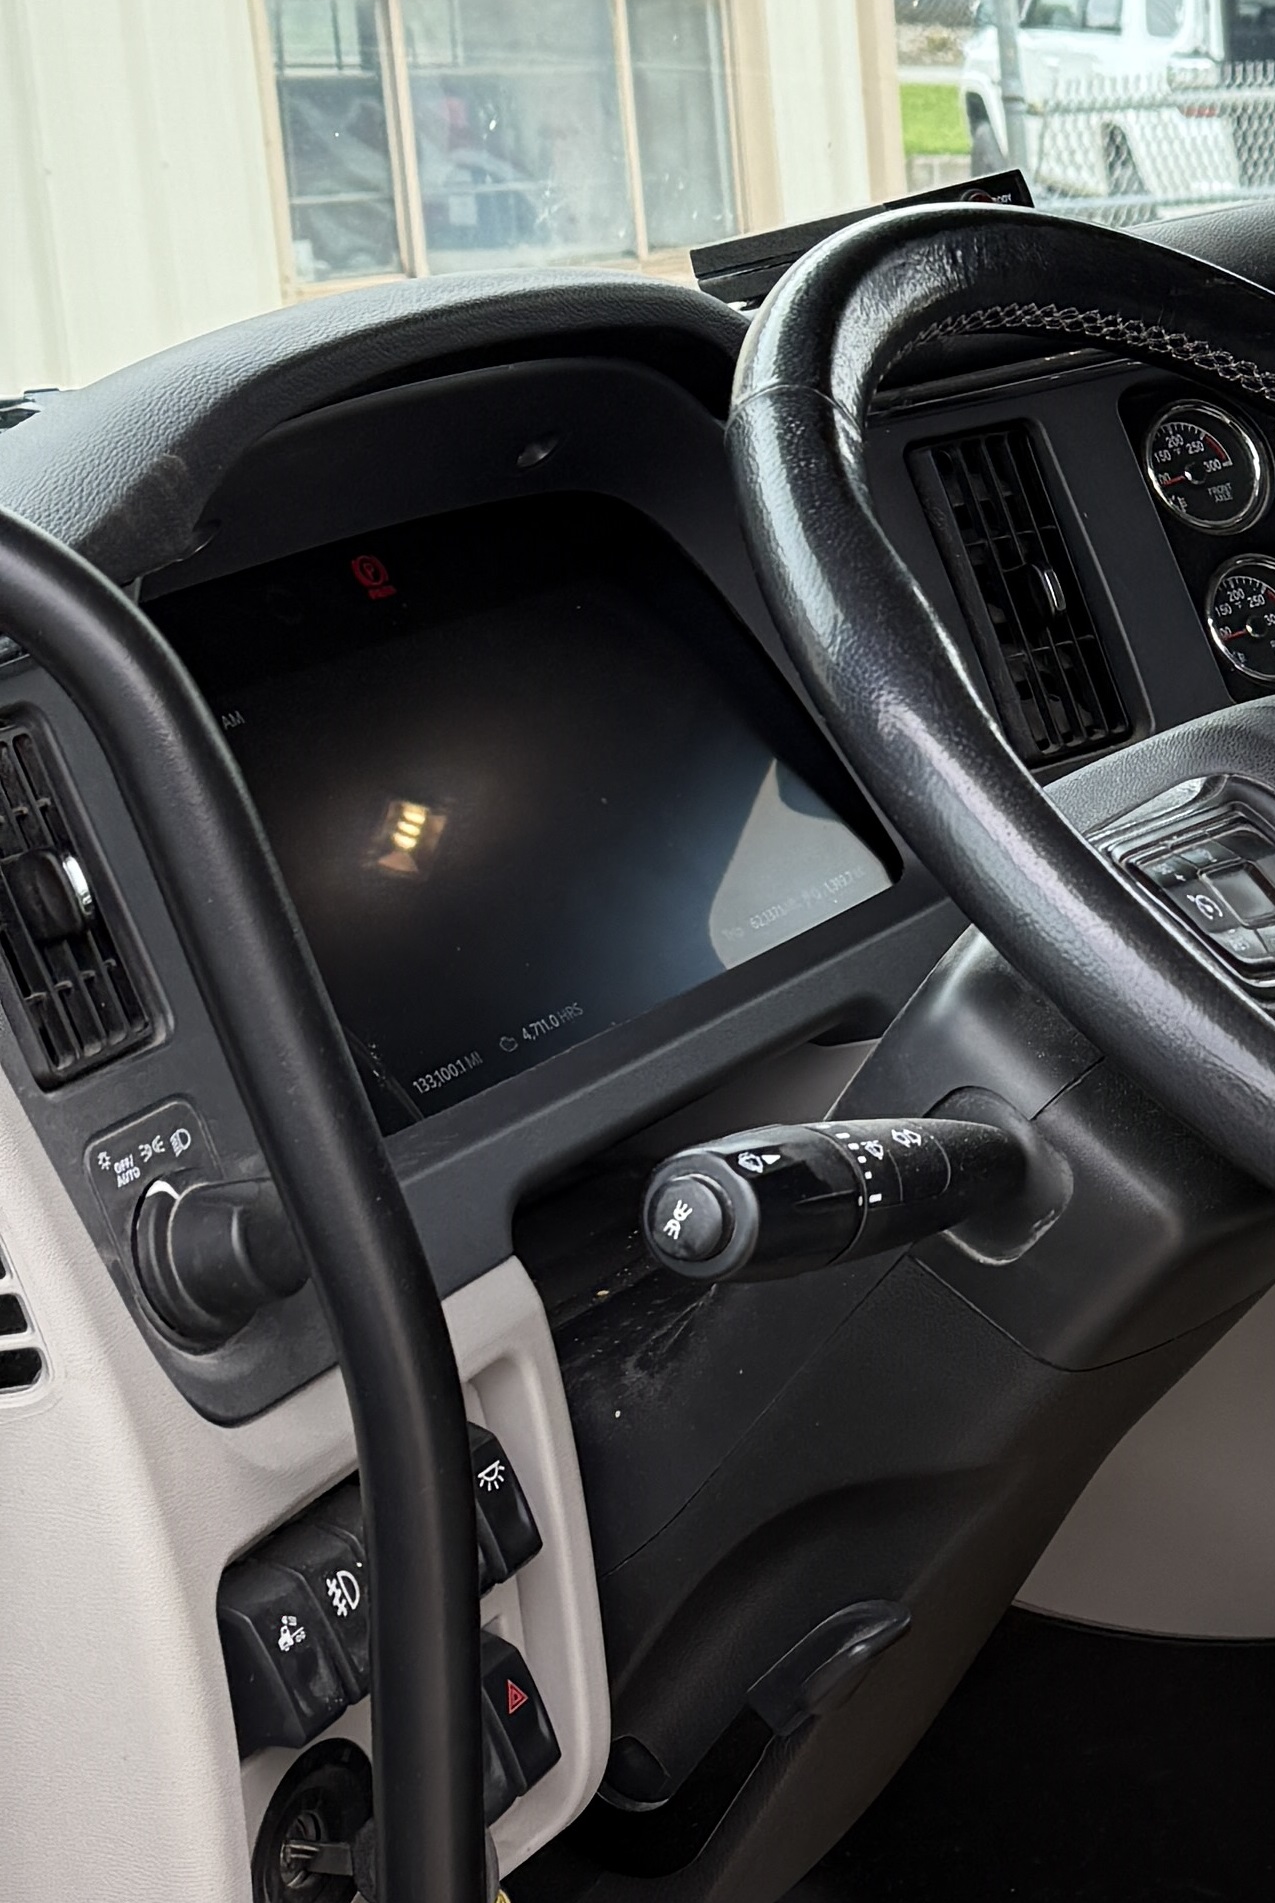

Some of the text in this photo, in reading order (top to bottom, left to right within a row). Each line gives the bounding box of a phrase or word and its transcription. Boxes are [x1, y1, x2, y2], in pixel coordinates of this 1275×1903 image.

[1166, 434, 1184, 448] 200
[1186, 440, 1204, 454] 250
[1154, 449, 1171, 463] 150
[1203, 458, 1221, 473] 300
[1227, 588, 1245, 602] 200
[1247, 594, 1265, 608] 250
[1215, 603, 1232, 616] 150
[557, 1002, 583, 1023] HRS
[464, 1051, 483, 1070] MI
[117, 1166, 141, 1188] AUTO
